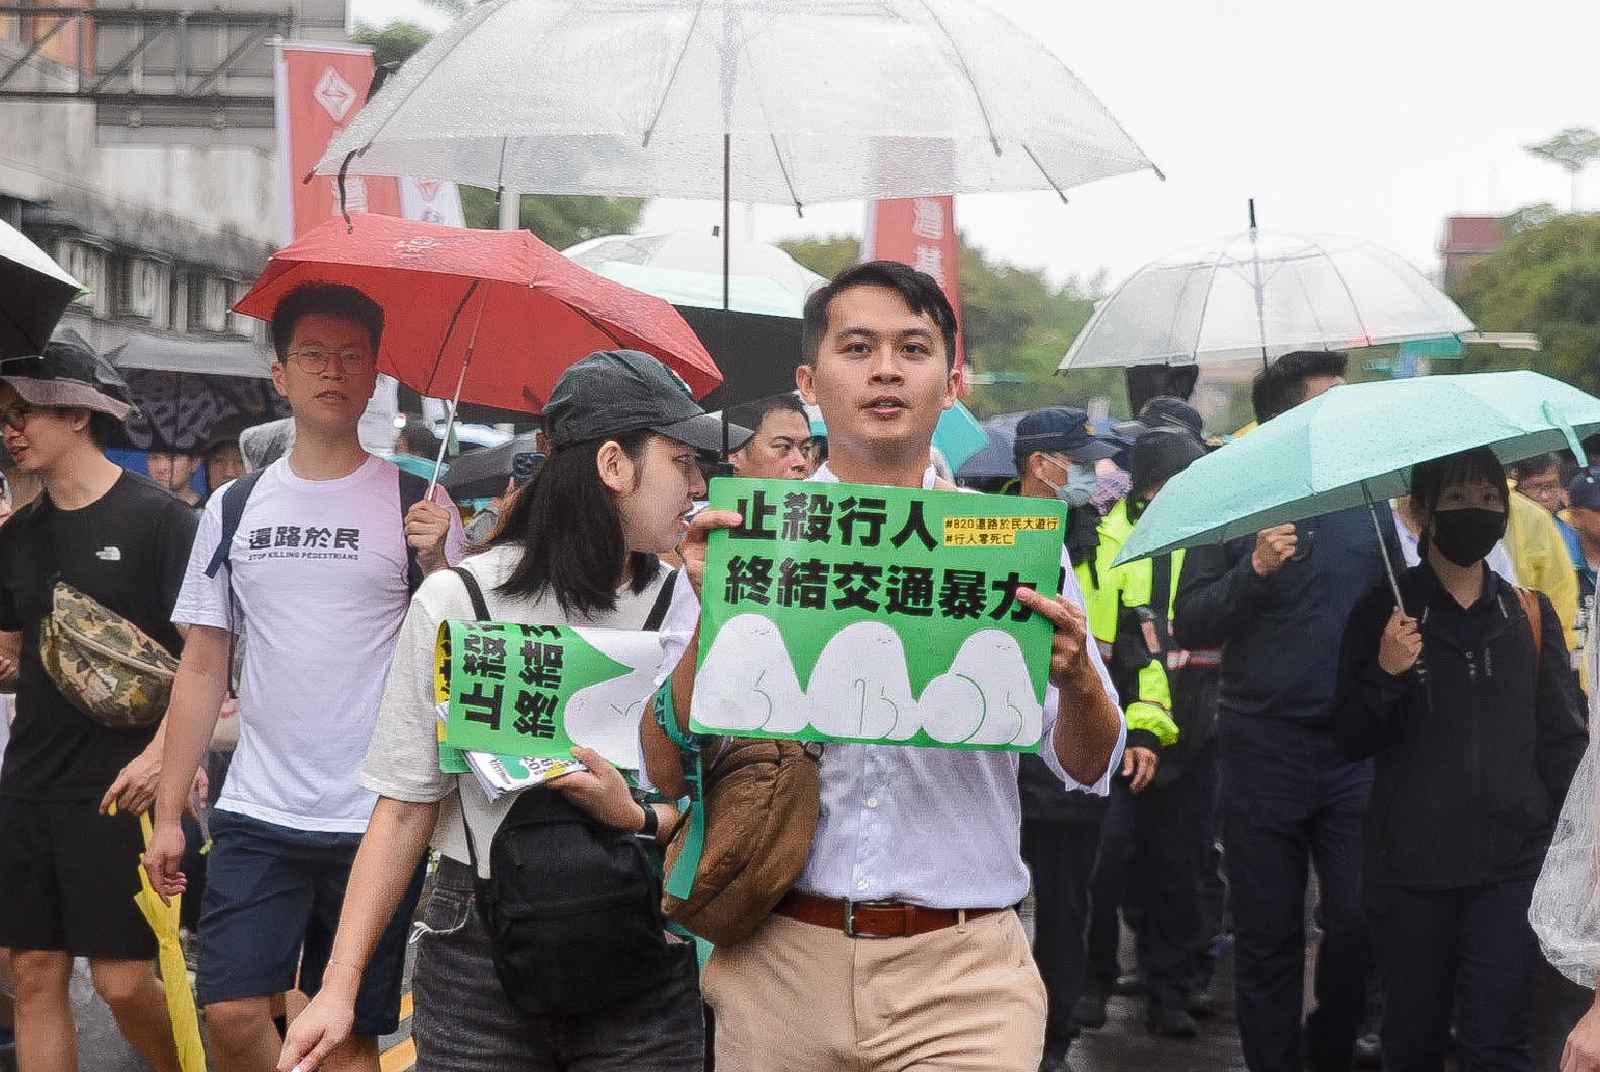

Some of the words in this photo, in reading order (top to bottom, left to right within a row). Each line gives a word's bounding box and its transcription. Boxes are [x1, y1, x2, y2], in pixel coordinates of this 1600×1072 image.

[728, 490, 939, 552] 止殺行人
[249, 526, 360, 551] 還路於民
[945, 533, 1014, 545] #行人零死亡
[268, 551, 299, 559] KILLING
[724, 555, 1037, 623] 終結交通暴力
